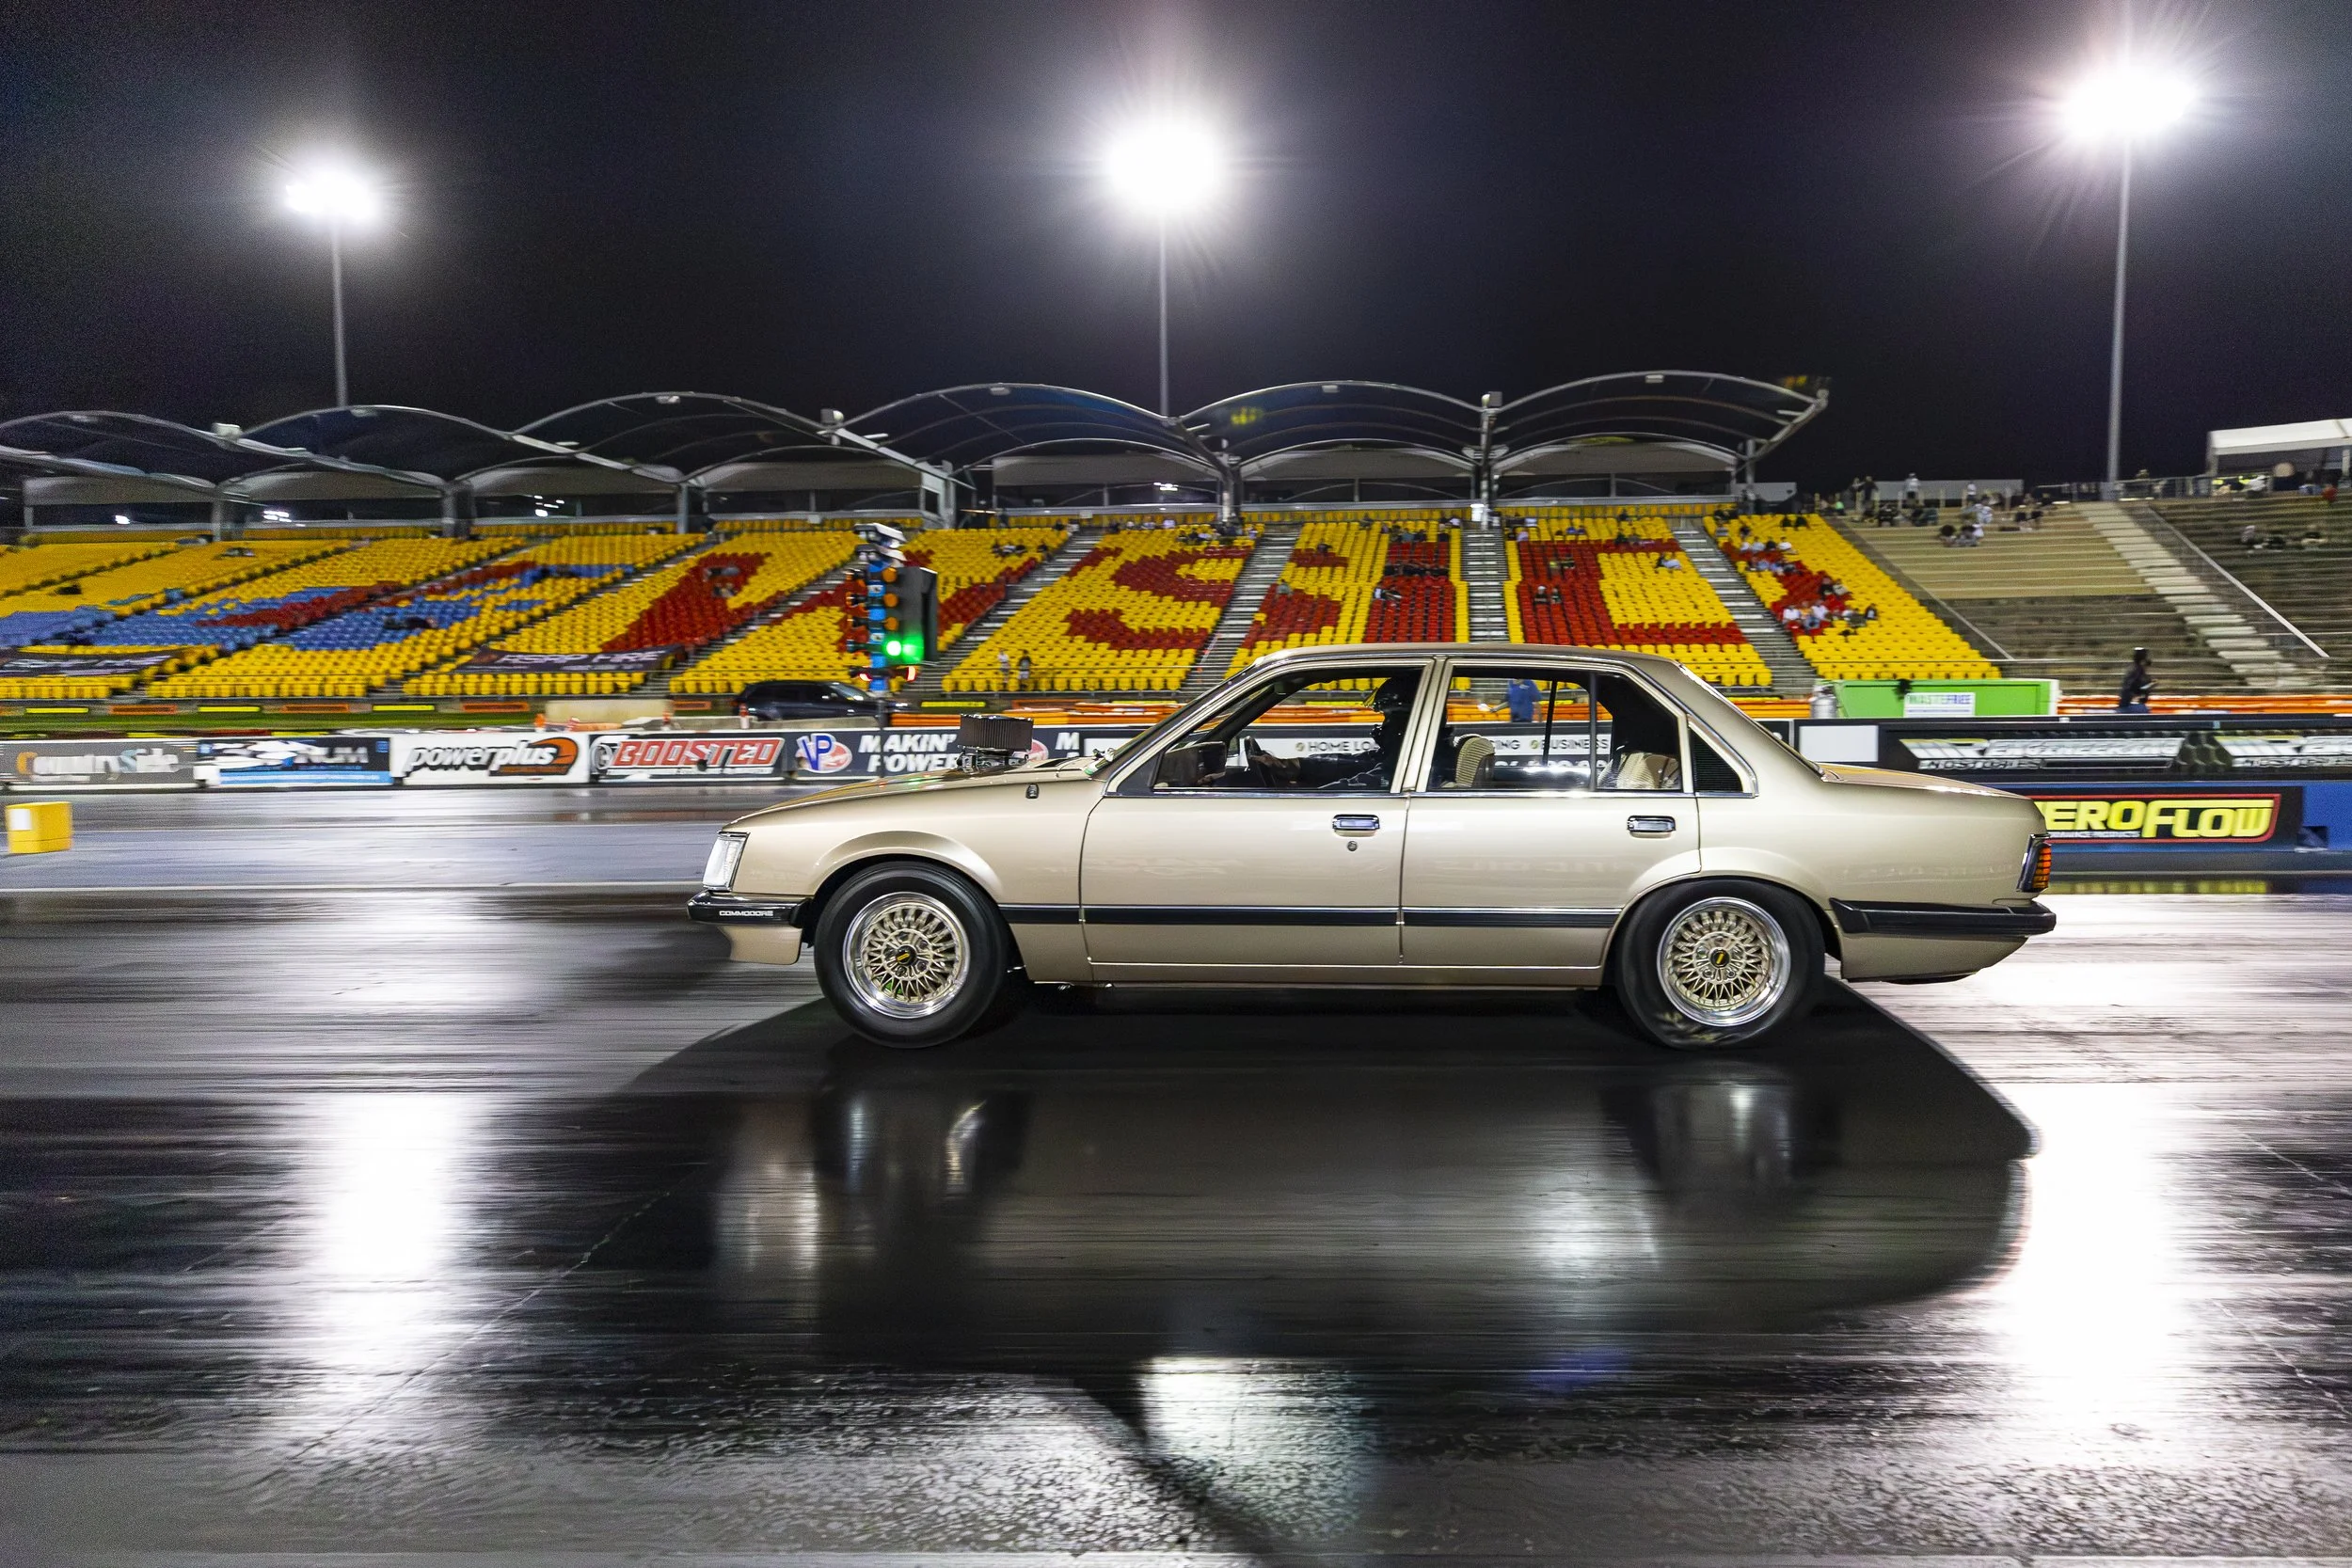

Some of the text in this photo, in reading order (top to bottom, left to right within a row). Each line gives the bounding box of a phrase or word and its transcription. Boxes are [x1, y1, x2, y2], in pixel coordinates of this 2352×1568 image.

[613, 738, 782, 767] BOOSTED
[858, 734, 958, 752] MAKIN'
[1308, 741, 1351, 752] HOME
[402, 739, 558, 778] powerplus
[867, 754, 959, 772] POWER
[2034, 799, 2274, 838] EROFLOW
